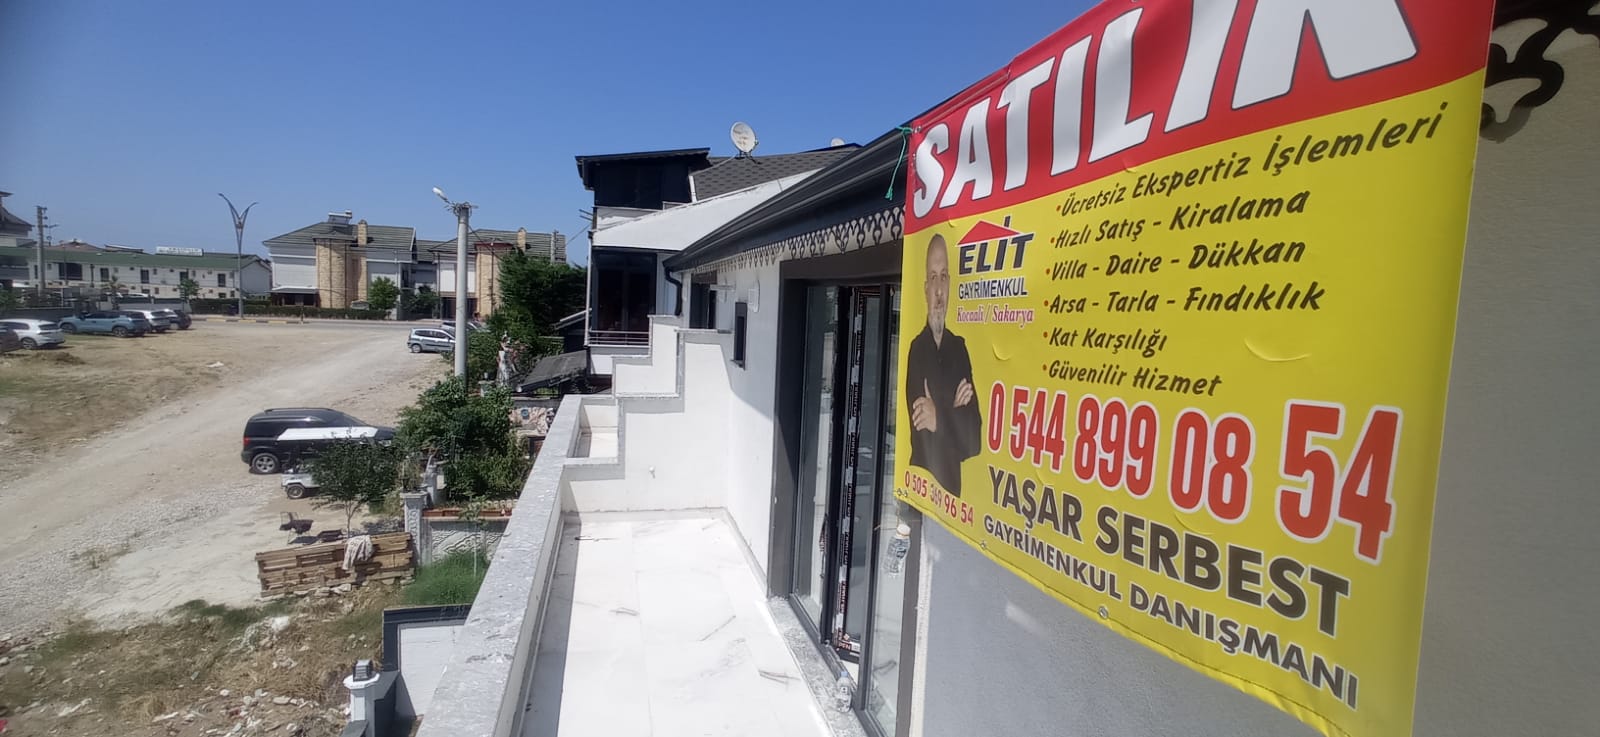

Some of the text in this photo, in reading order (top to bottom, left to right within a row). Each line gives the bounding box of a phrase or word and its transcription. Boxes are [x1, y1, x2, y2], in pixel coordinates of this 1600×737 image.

[1061, 102, 1448, 217] Ücretsiz Ekspertiz İşlemleri
[1055, 224, 1092, 249] Hızlı
[1096, 219, 1145, 242] Satış
[1169, 190, 1311, 231] Kiralama
[1052, 259, 1087, 281] Villa
[1106, 251, 1162, 276] Daire
[1188, 238, 1306, 269] Dükkan
[958, 278, 1027, 299] GAYRİMENKUL
[1049, 294, 1087, 314] Arsa
[1107, 289, 1159, 312] Tarla
[1183, 281, 1325, 312] Fındıklık
[993, 305, 1034, 328] Sakarya
[1049, 327, 1167, 358] Kat Karşılığı
[1049, 359, 1222, 396] Güvenilir Hizmet
[988, 383, 1402, 561] 0 544 899 08 54
[905, 471, 911, 488] 0
[912, 474, 928, 498] 505
[944, 494, 957, 518] 96
[961, 502, 974, 527] 54
[987, 466, 1349, 636] YAŞAR SERBEST
[984, 514, 1358, 710] GAYRİMENKUL DANIŞMANI
